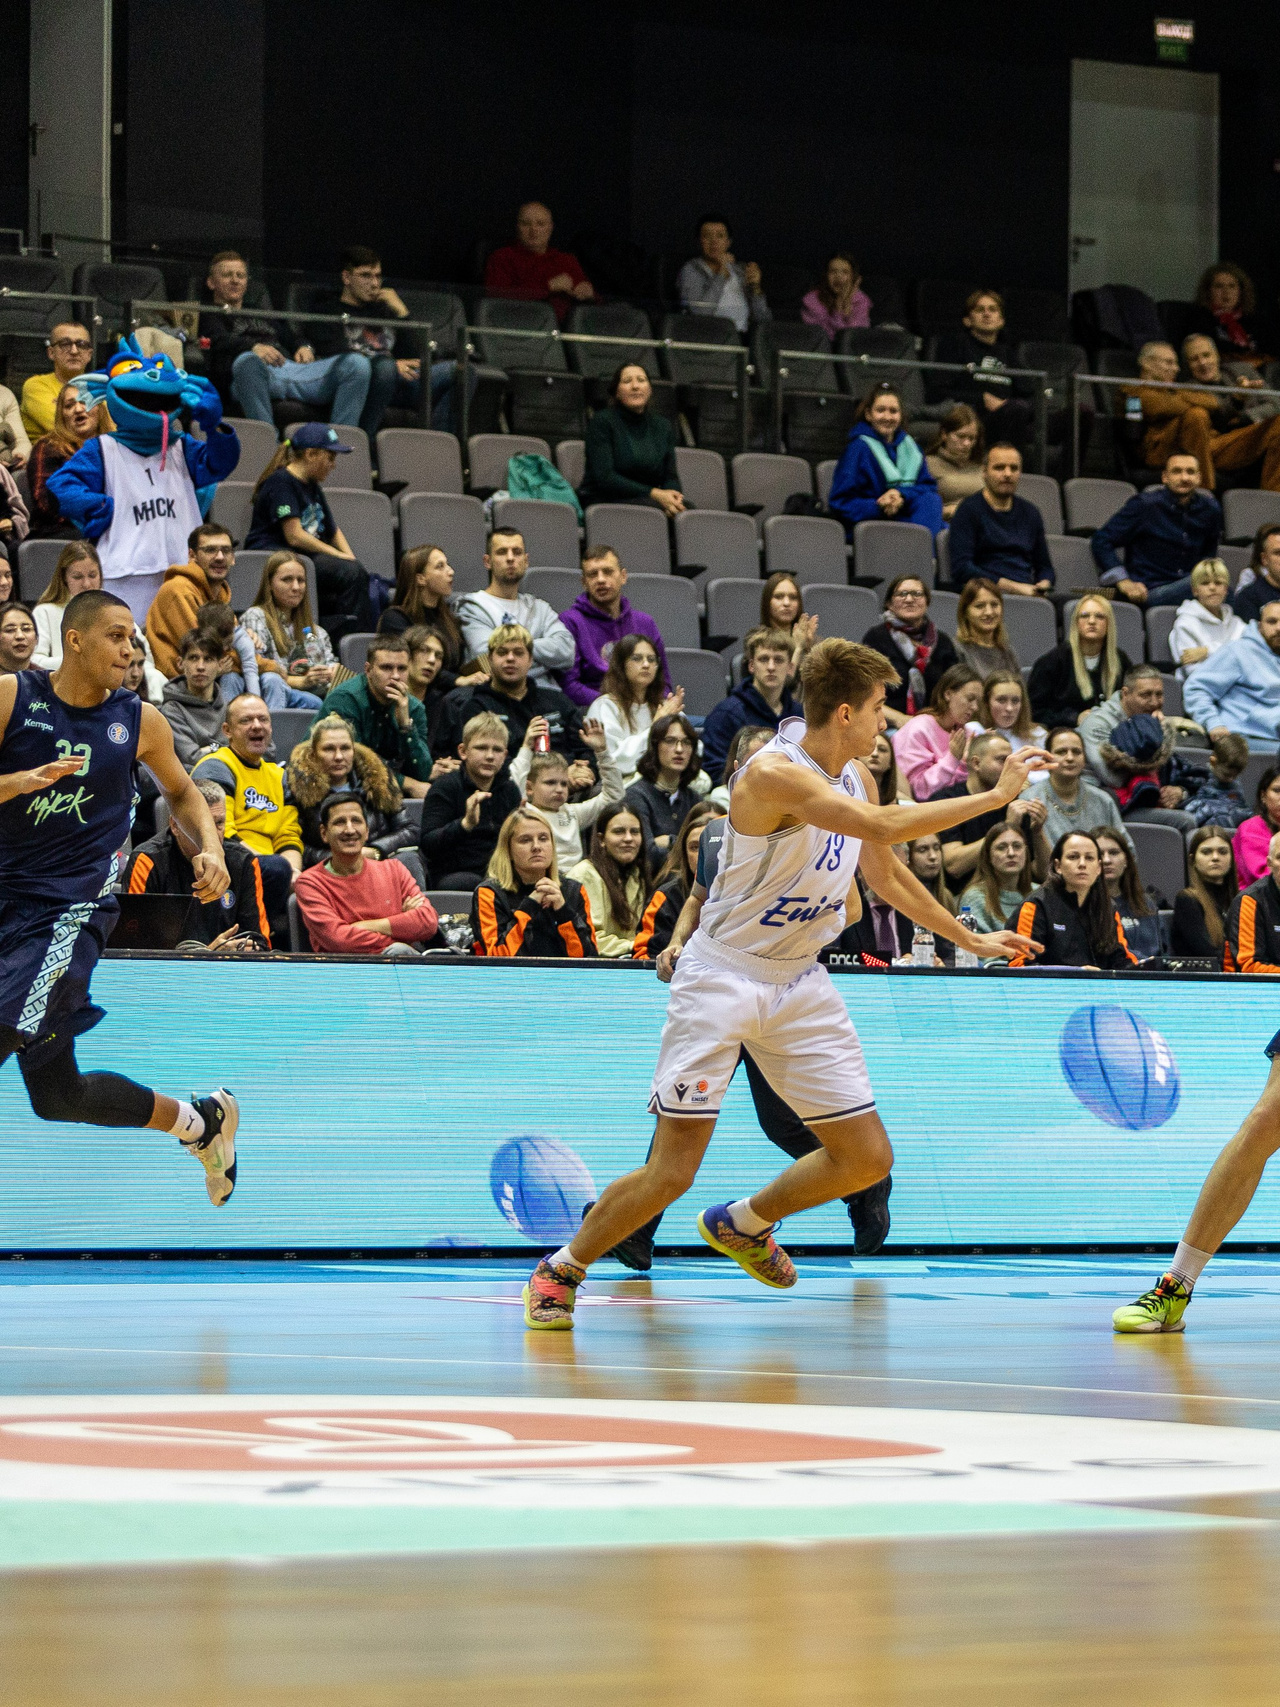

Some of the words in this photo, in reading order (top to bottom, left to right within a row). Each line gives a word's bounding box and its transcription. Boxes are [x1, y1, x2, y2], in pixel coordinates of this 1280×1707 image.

[145, 468, 154, 486] 1
[24, 718, 54, 731] Kempa
[815, 833, 845, 872] 13
